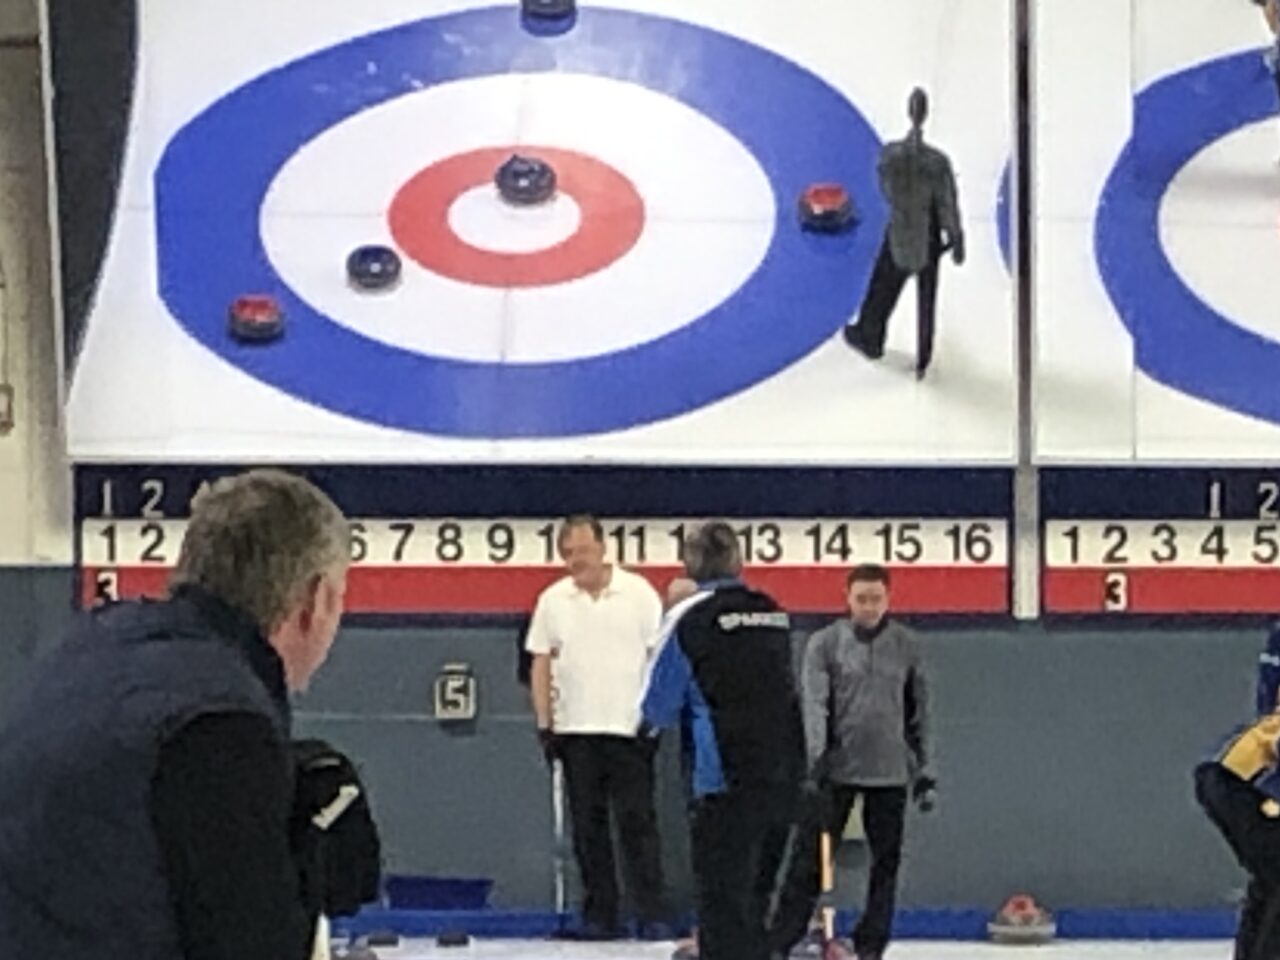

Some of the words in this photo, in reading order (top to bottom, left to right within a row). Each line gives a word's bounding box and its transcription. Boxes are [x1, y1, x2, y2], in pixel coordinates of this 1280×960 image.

[142, 479, 164, 518] 2
[1208, 481, 1221, 518] 1
[1258, 481, 1279, 519] 2
[101, 523, 116, 562] 1
[141, 523, 165, 562] 2
[389, 523, 415, 561] 7
[437, 522, 463, 562] 8
[488, 522, 514, 563] 9
[609, 524, 646, 562] 11
[738, 523, 783, 563] 13
[806, 523, 852, 562] 14
[876, 523, 922, 563] 15
[945, 523, 992, 563] 16
[1063, 525, 1079, 563] 1
[1103, 524, 1128, 564] 2
[1151, 524, 1177, 564] 3
[1201, 525, 1228, 563] 4
[1253, 524, 1279, 564] 5
[1106, 572, 1128, 612] 3
